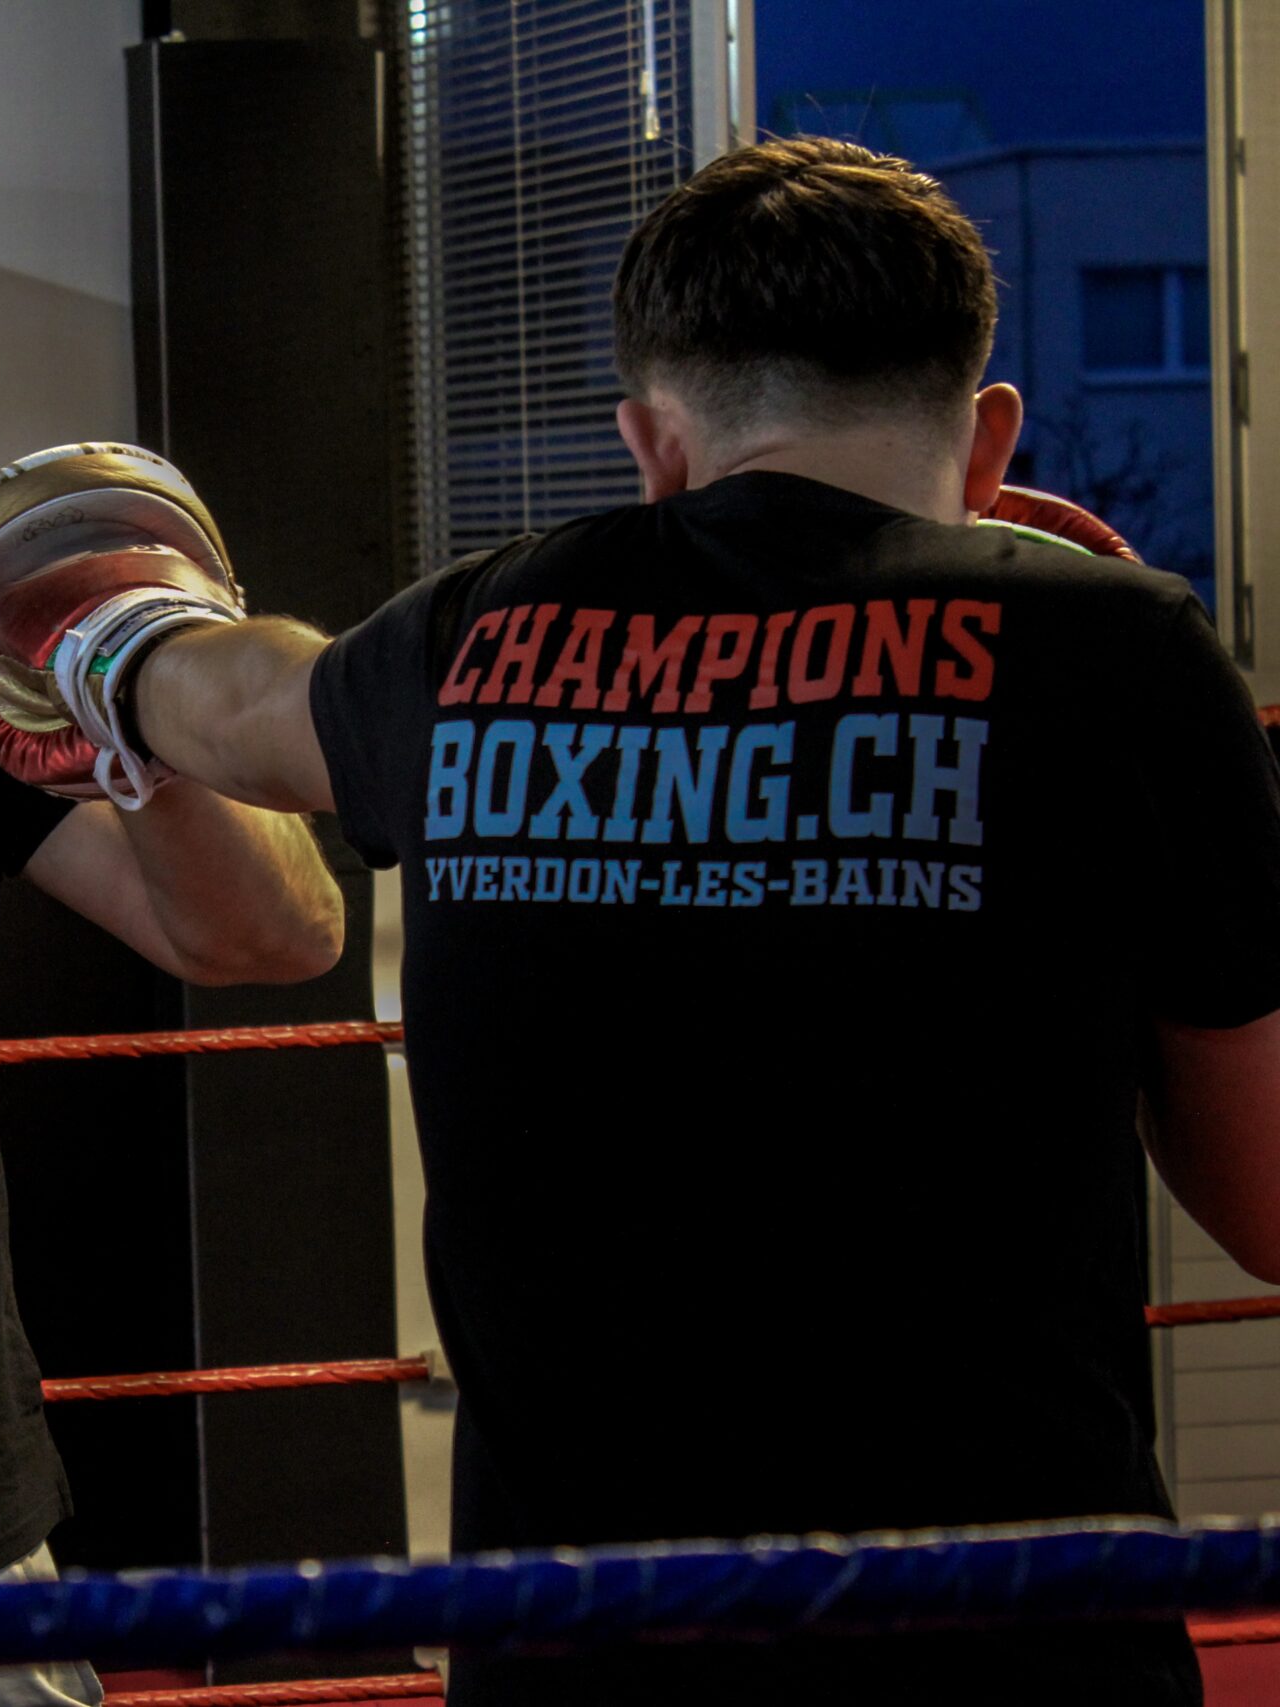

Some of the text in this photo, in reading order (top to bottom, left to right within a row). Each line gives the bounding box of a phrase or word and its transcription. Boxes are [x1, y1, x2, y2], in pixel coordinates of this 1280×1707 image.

[436, 598, 1002, 715] CHAMPIONS
[424, 712, 990, 848] BOXING.CH
[424, 856, 984, 913] YVERDON-LES-BAINS
